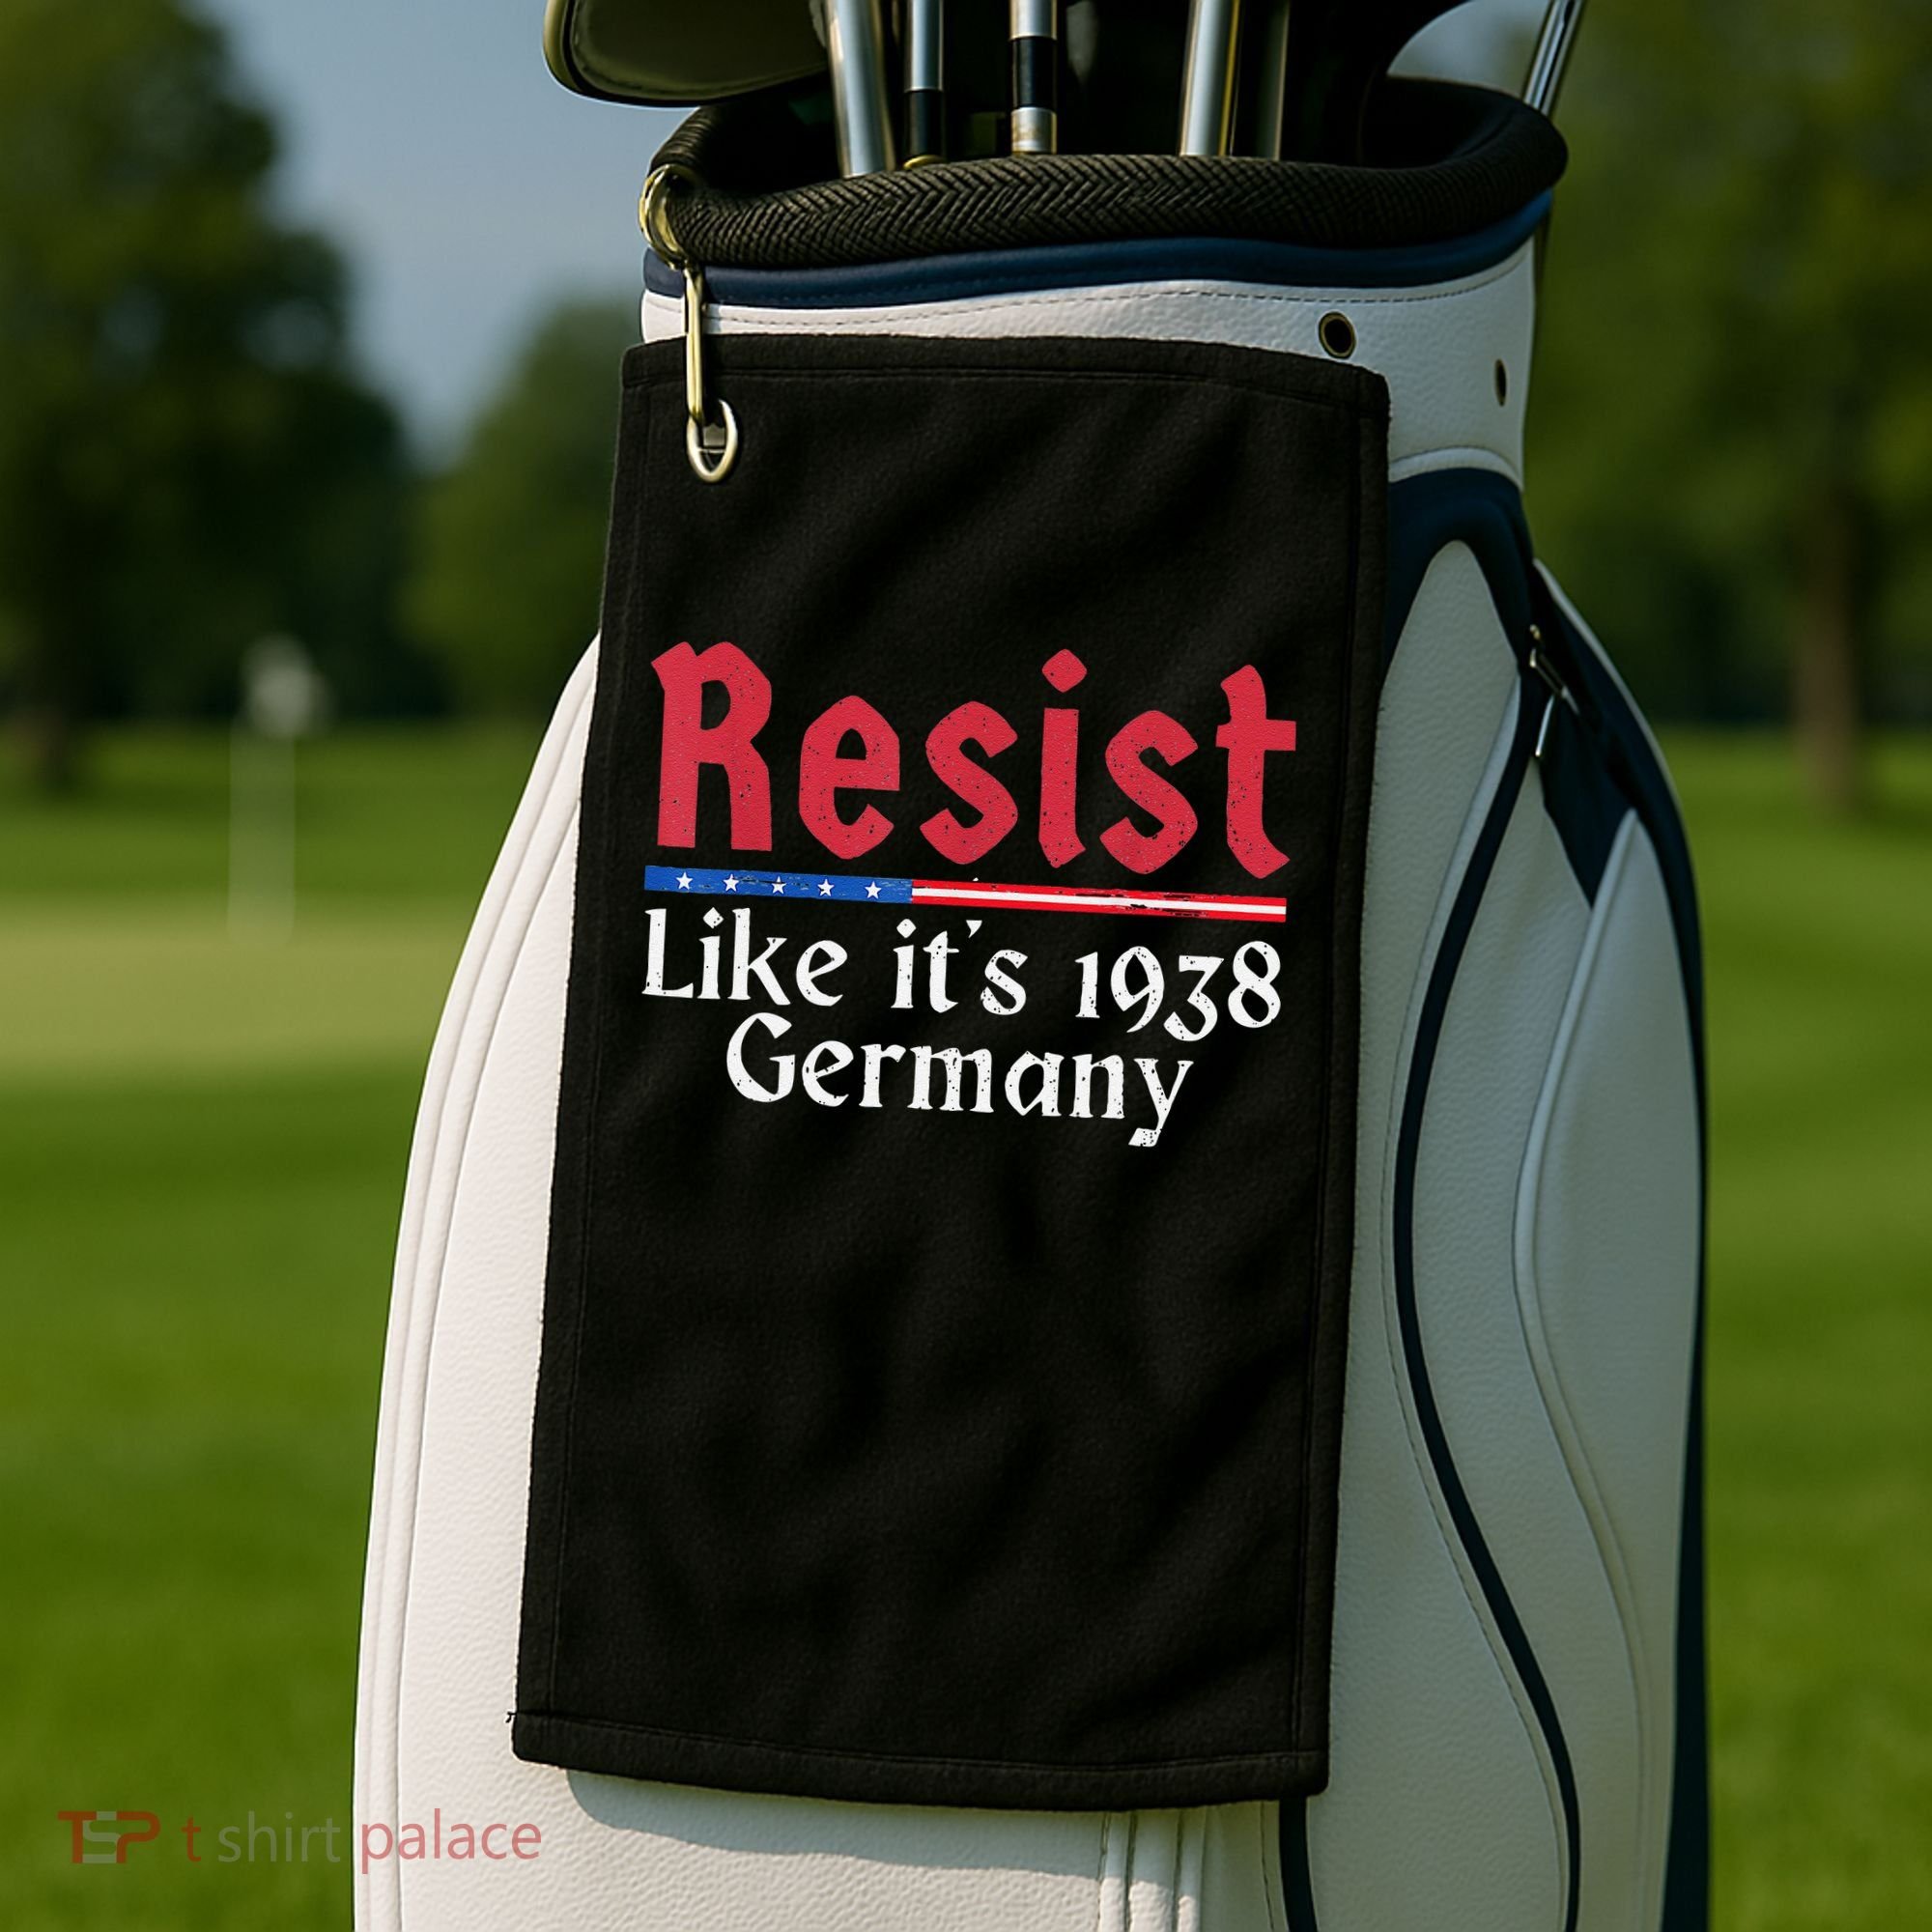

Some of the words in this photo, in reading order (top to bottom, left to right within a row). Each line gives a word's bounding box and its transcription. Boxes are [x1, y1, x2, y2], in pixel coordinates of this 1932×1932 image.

[651, 641, 1296, 879] Resist
[641, 906, 848, 1007] Like
[892, 918, 1029, 1016] it's
[1075, 940, 1282, 1042] 1938
[725, 1011, 1194, 1148] Germany
